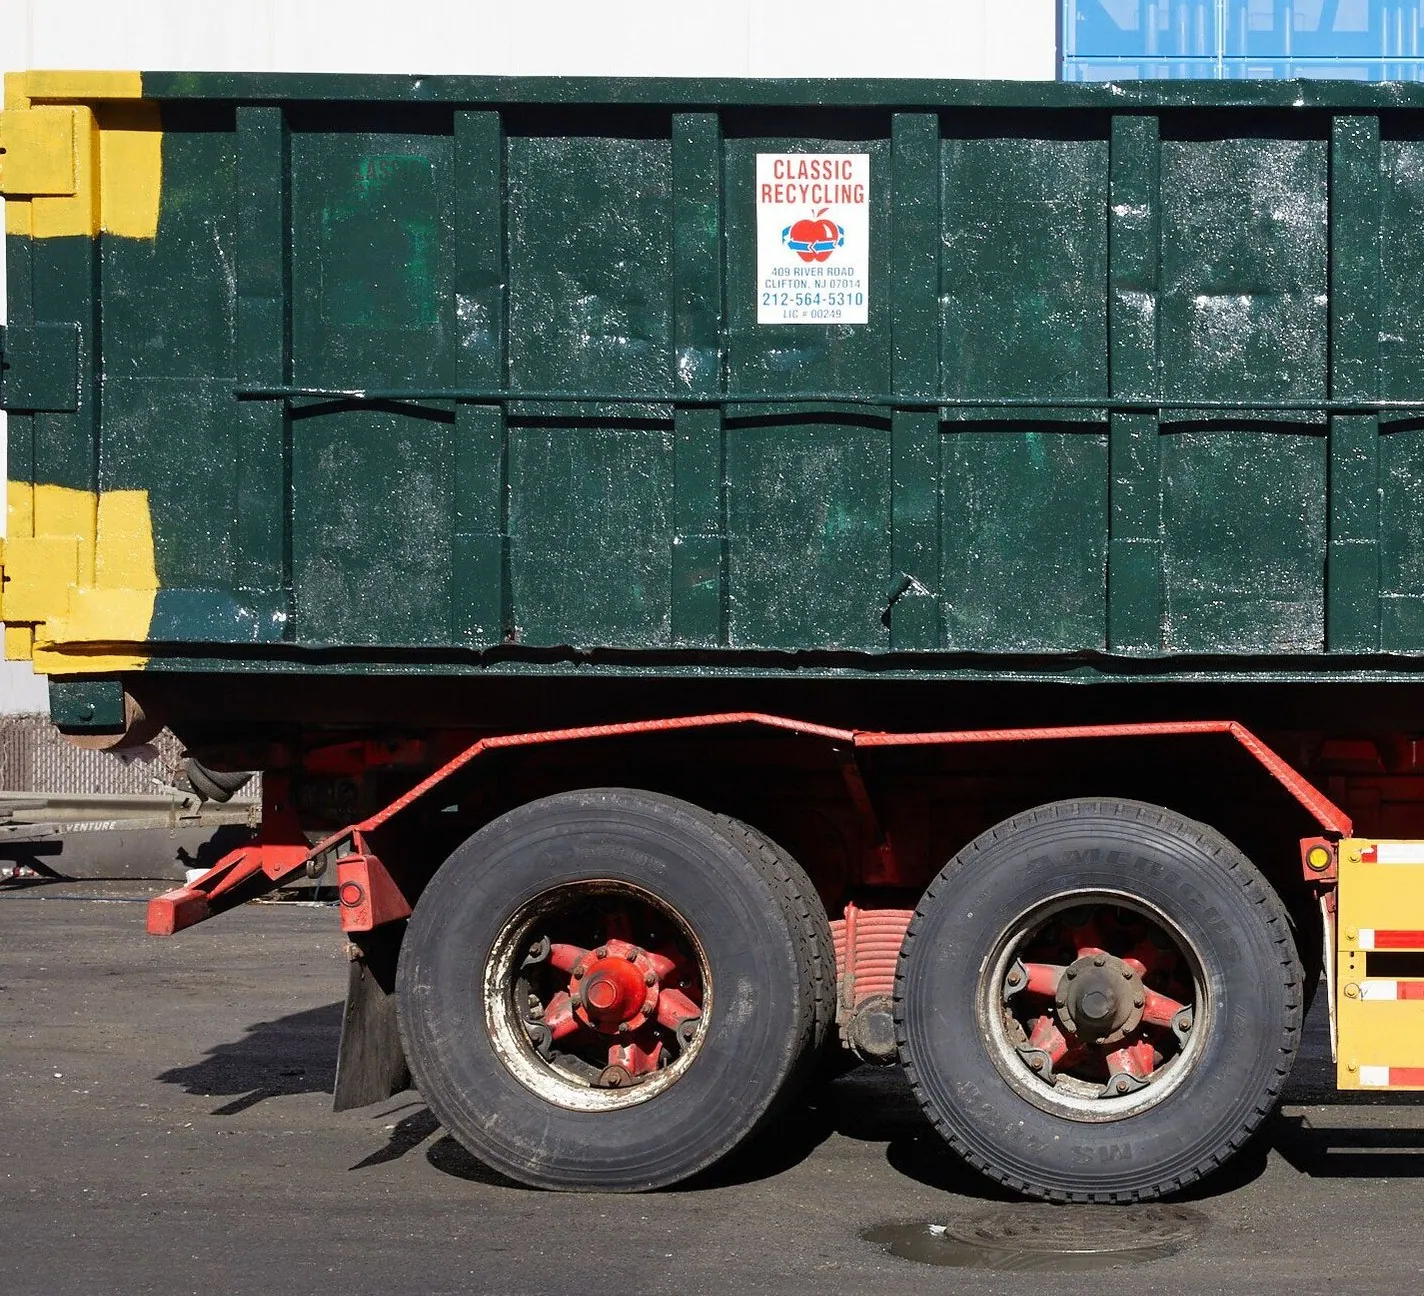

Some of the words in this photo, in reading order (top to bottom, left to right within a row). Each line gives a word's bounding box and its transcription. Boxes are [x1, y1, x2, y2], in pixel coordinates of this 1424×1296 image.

[774, 160, 852, 179] CLASSIC
[762, 184, 864, 203] RECYCLING
[772, 268, 790, 276] 409
[794, 268, 823, 276] RIVER
[827, 268, 854, 276] ROAD
[765, 280, 810, 289] CLIFTON,
[815, 280, 826, 288] NJ
[830, 280, 860, 288] 07014
[763, 293, 863, 306] 212-564-5310
[783, 310, 798, 318] LIC
[811, 310, 841, 318] 00249
[66, 821, 116, 832] VENTURE
